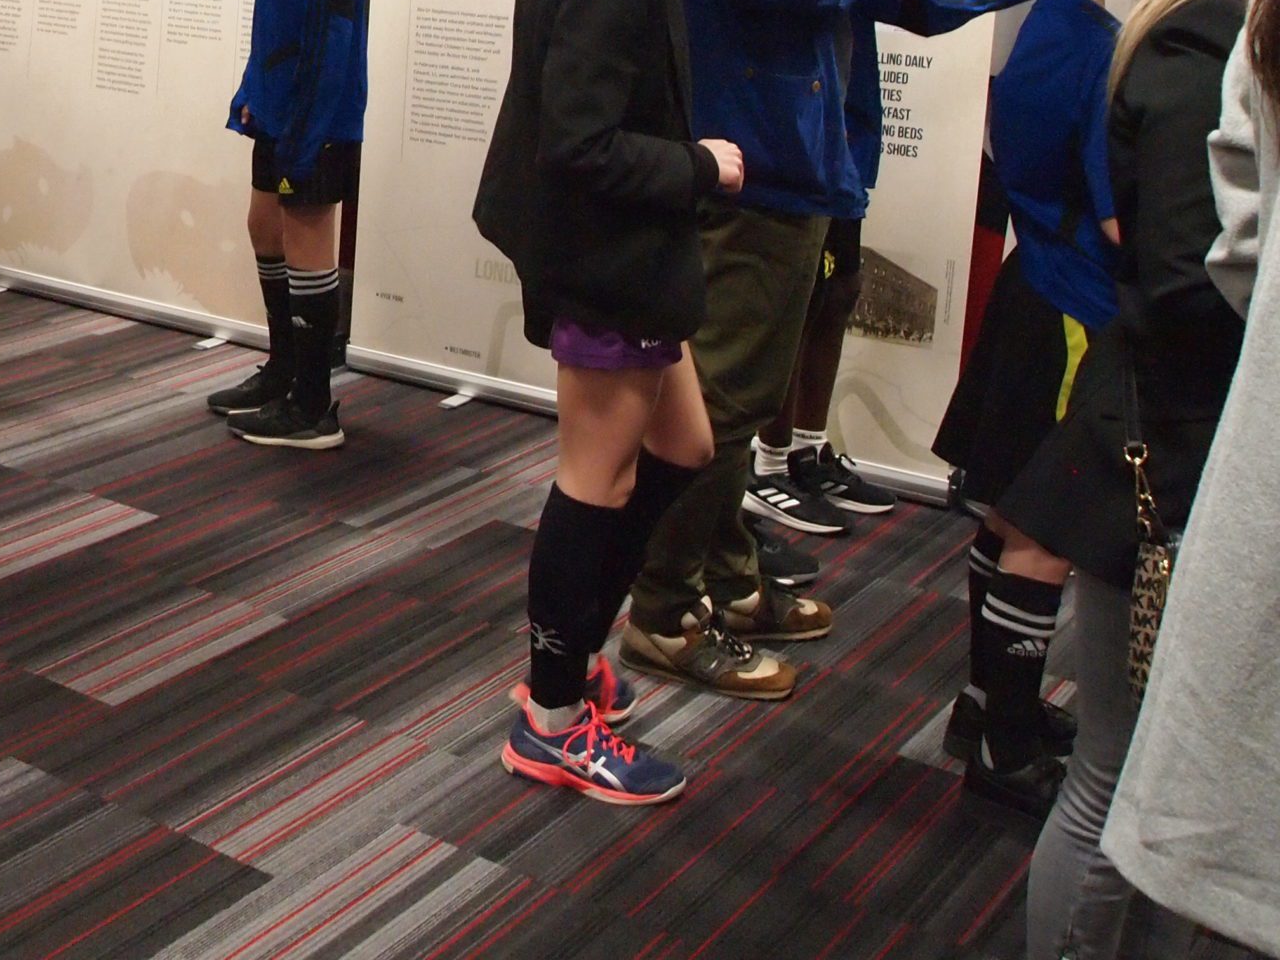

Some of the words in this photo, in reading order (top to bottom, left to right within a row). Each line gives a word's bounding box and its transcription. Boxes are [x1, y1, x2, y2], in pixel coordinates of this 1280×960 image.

[905, 54, 933, 69] DAILY
[897, 126, 923, 141] BEDS
[886, 142, 918, 158] SHOES
